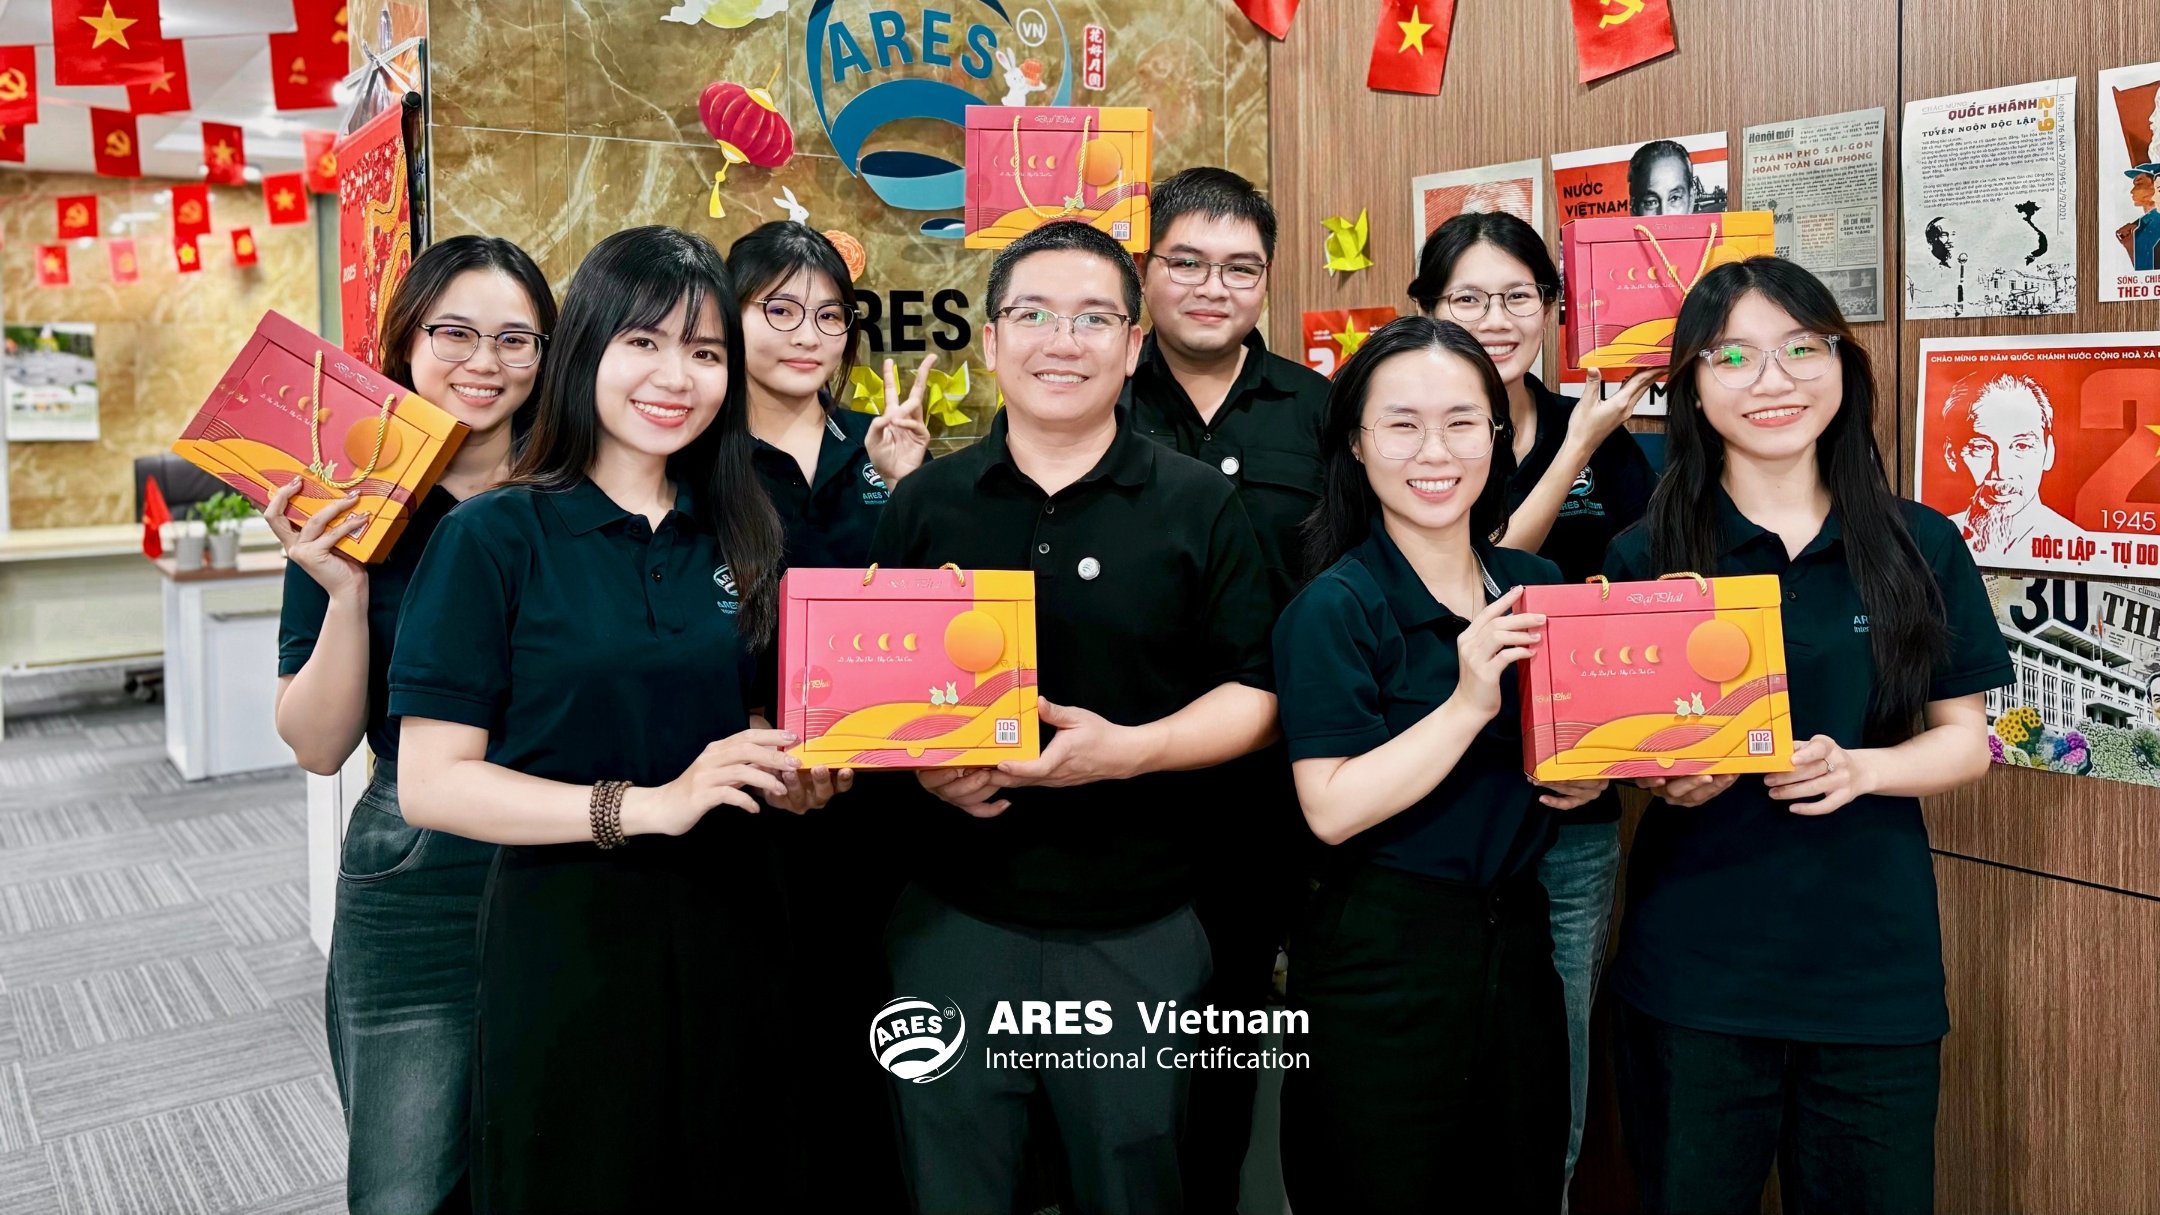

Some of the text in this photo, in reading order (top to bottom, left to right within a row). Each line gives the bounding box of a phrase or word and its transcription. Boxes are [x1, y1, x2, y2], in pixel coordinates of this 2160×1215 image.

[1022, 22, 1043, 39] VN
[828, 9, 998, 83] ARES
[1948, 98, 2038, 120] QUỐC KHÁNH
[2058, 124, 2066, 133] 76
[1114, 223, 1128, 231] 105
[2117, 285, 2149, 298] THEO
[854, 289, 971, 352] RES
[1931, 355, 1953, 363] CHÀO
[1991, 353, 2009, 361] NĂM
[2010, 352, 2035, 361] QUỐC
[2037, 352, 2066, 361] KHÁNH
[2068, 351, 2092, 360] NƯỚC
[2094, 351, 2120, 361] CỘNG
[2122, 350, 2141, 359] HOÀ
[1560, 500, 1580, 511] RES
[2101, 509, 2157, 531] 1945
[2031, 534, 2063, 564] ĐỘC
[2067, 536, 2096, 566] LẬP
[2111, 540, 2133, 569] TỰ
[2136, 543, 2159, 566] DO
[998, 721, 1016, 731] 105
[1750, 732, 1770, 742] 102
